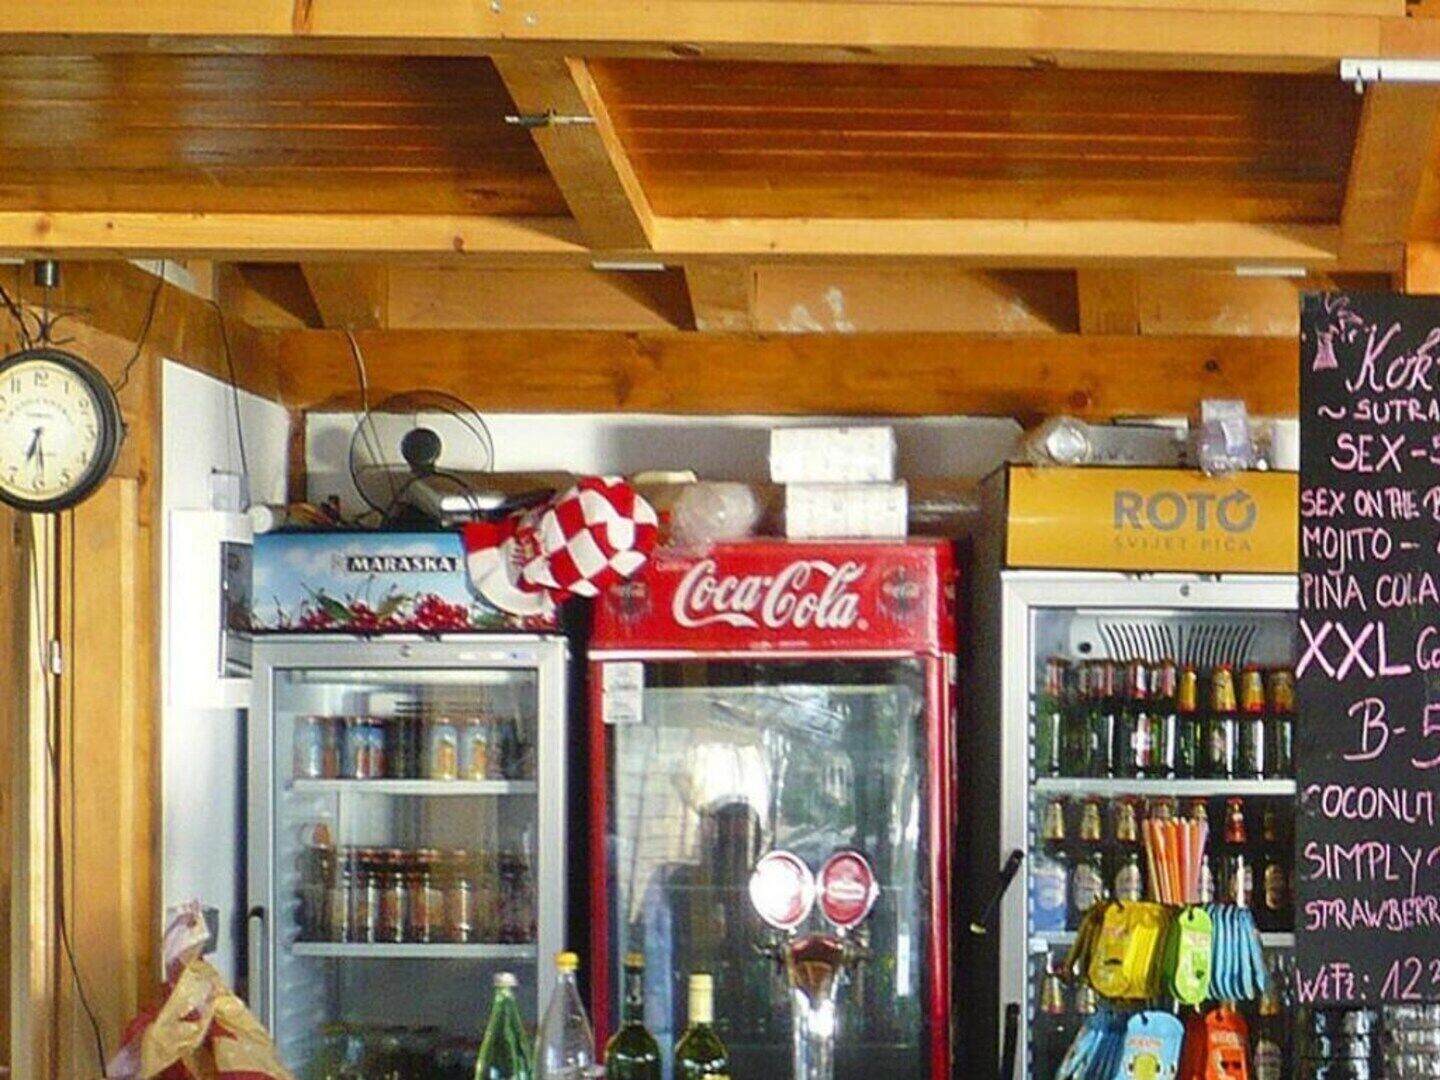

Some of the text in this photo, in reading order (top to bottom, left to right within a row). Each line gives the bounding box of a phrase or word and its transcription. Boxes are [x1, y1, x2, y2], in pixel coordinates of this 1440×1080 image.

[1354, 399, 1440, 424] SUTRA
[1331, 433, 1405, 474] SEX
[1114, 489, 1257, 532] ROTO
[1300, 488, 1345, 519] SEX
[350, 557, 452, 573] MARASKA
[1303, 526, 1391, 575] MOJITO
[672, 559, 868, 629] Coca-Cola
[1296, 618, 1411, 682] XXL
[1304, 841, 1421, 899] SIMPLY
